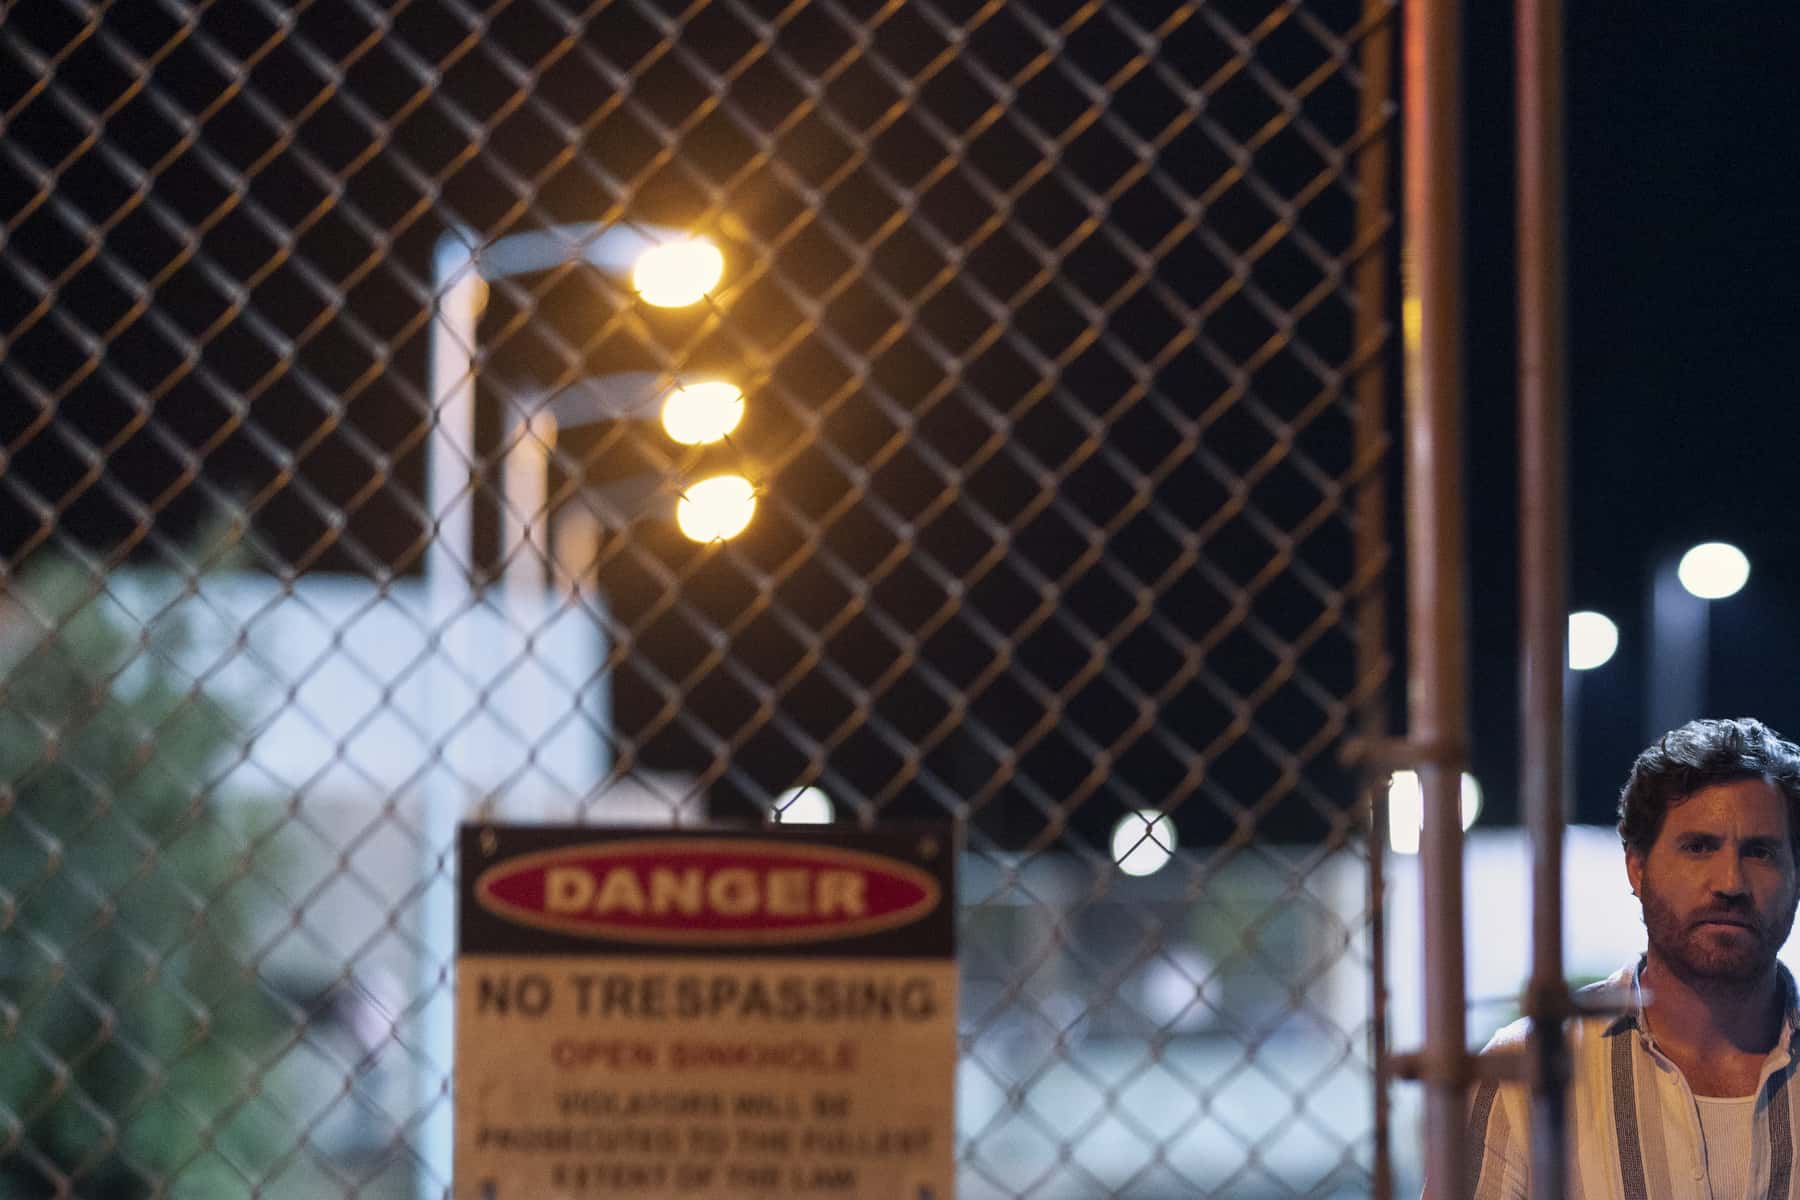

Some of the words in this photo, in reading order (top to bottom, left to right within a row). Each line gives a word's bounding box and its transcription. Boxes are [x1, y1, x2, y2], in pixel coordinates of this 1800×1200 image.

[543, 867, 868, 916] DANGER
[476, 974, 553, 1019] NO
[571, 973, 937, 1023] TRESPASSING
